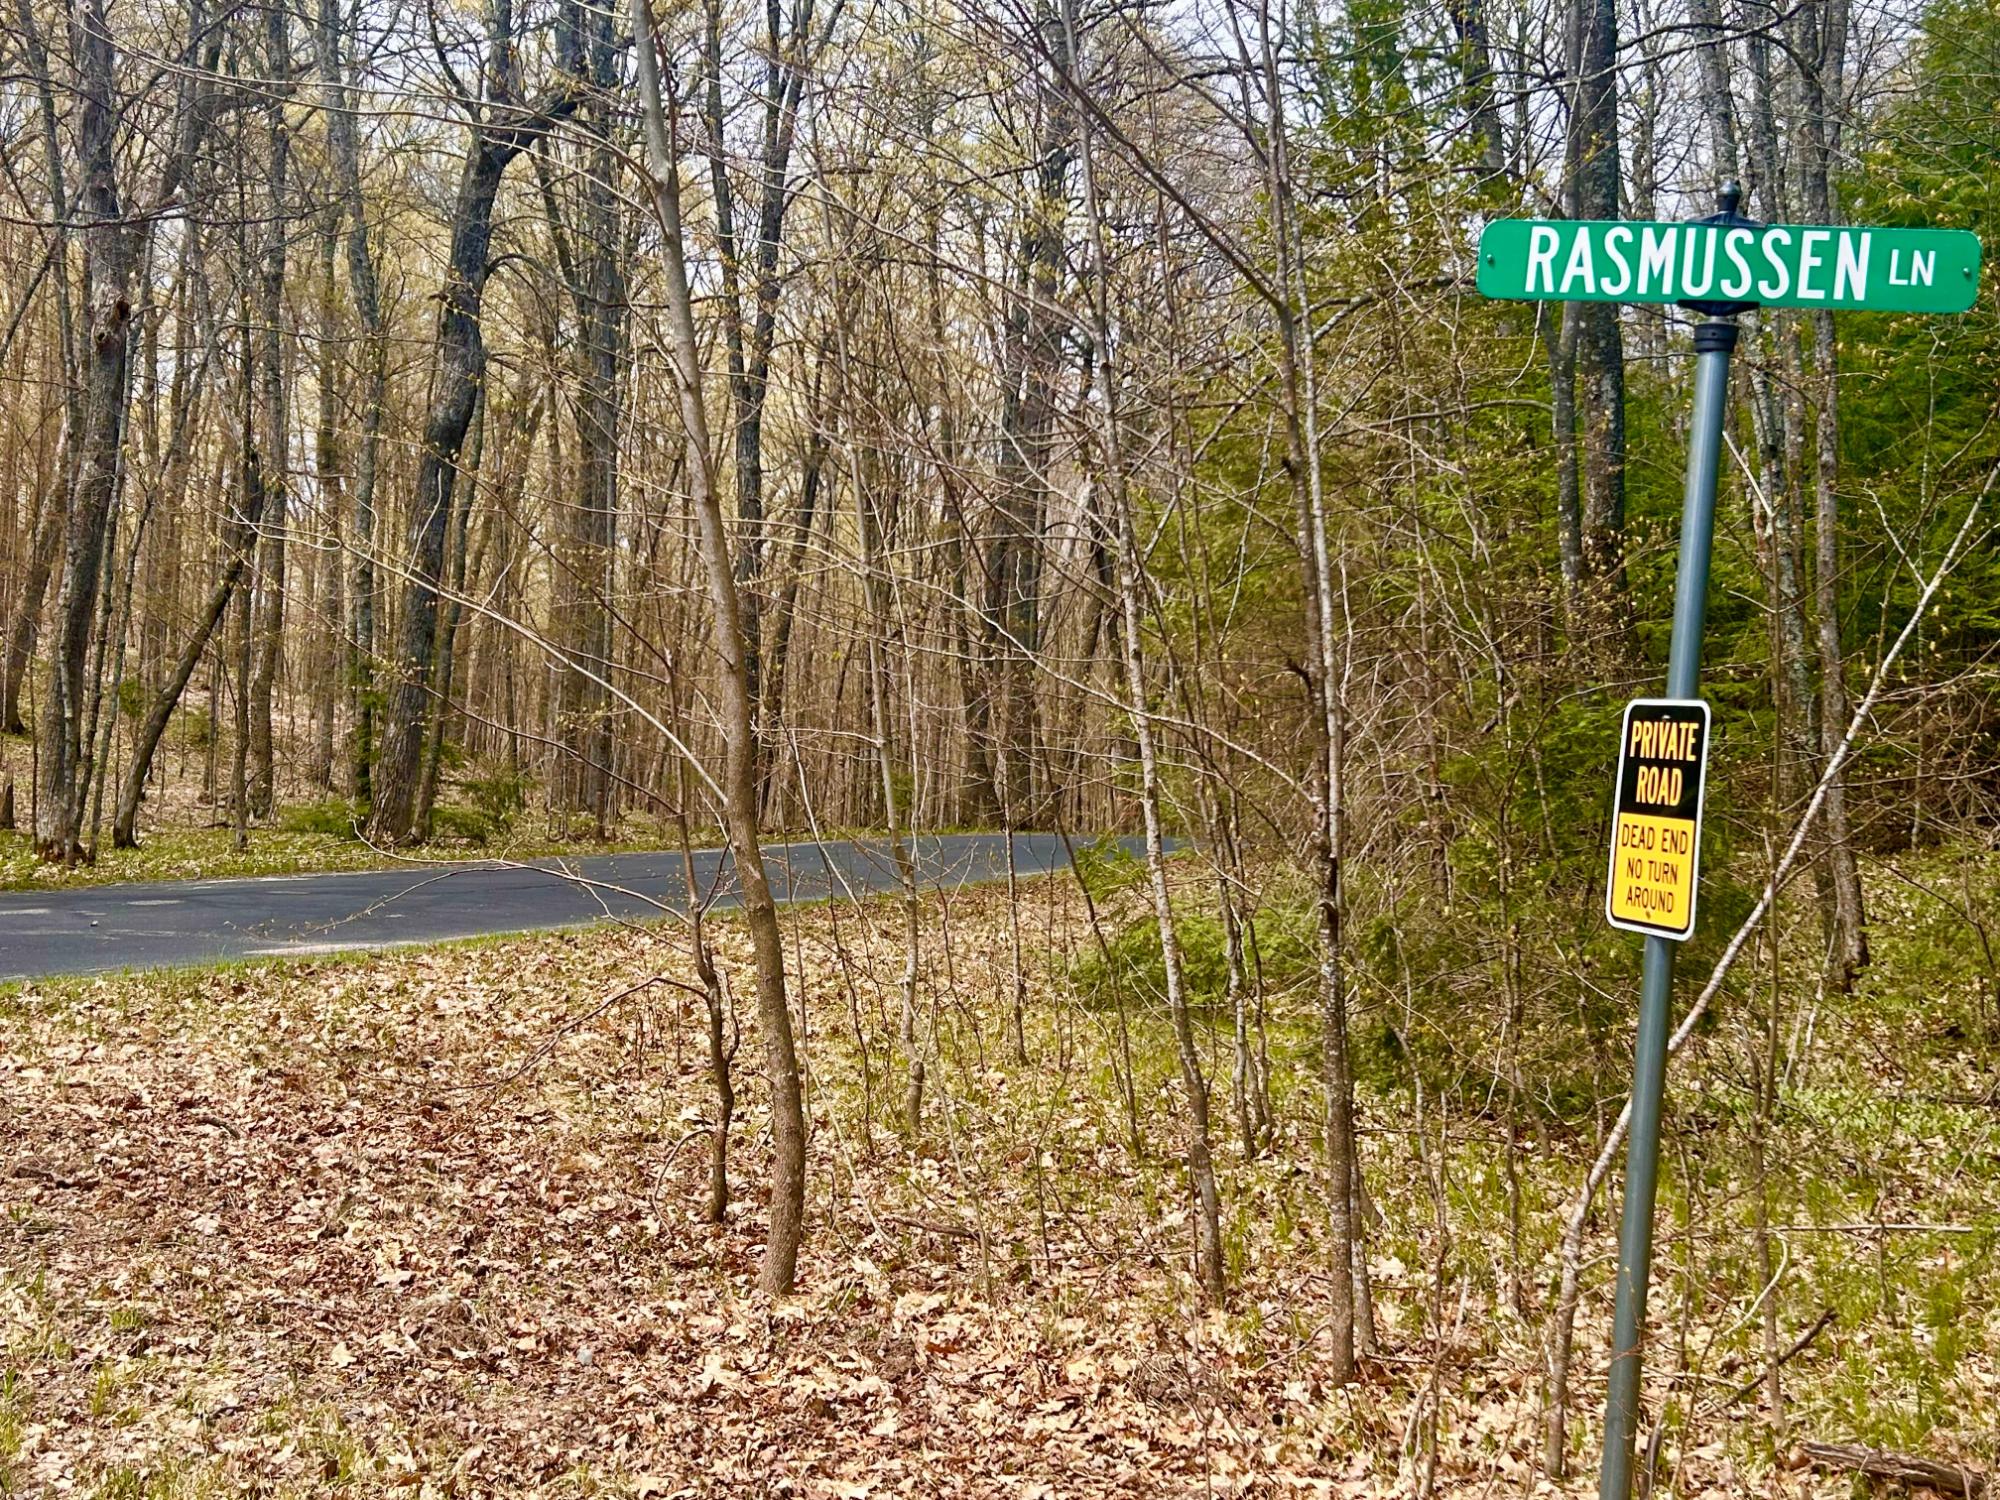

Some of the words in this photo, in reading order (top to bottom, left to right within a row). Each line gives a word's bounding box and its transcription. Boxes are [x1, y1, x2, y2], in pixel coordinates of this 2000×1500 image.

[1525, 226, 1872, 301] RASMUSSEN
[1888, 249, 1936, 286] LN
[1629, 721, 1699, 761] PRIVATE
[1636, 766, 1682, 806] ROAD
[1622, 824, 1655, 850] DEAD
[1661, 828, 1689, 855] END
[1626, 857, 1643, 879] NO
[1648, 860, 1679, 886] TURN
[1625, 886, 1674, 914] AROUND
